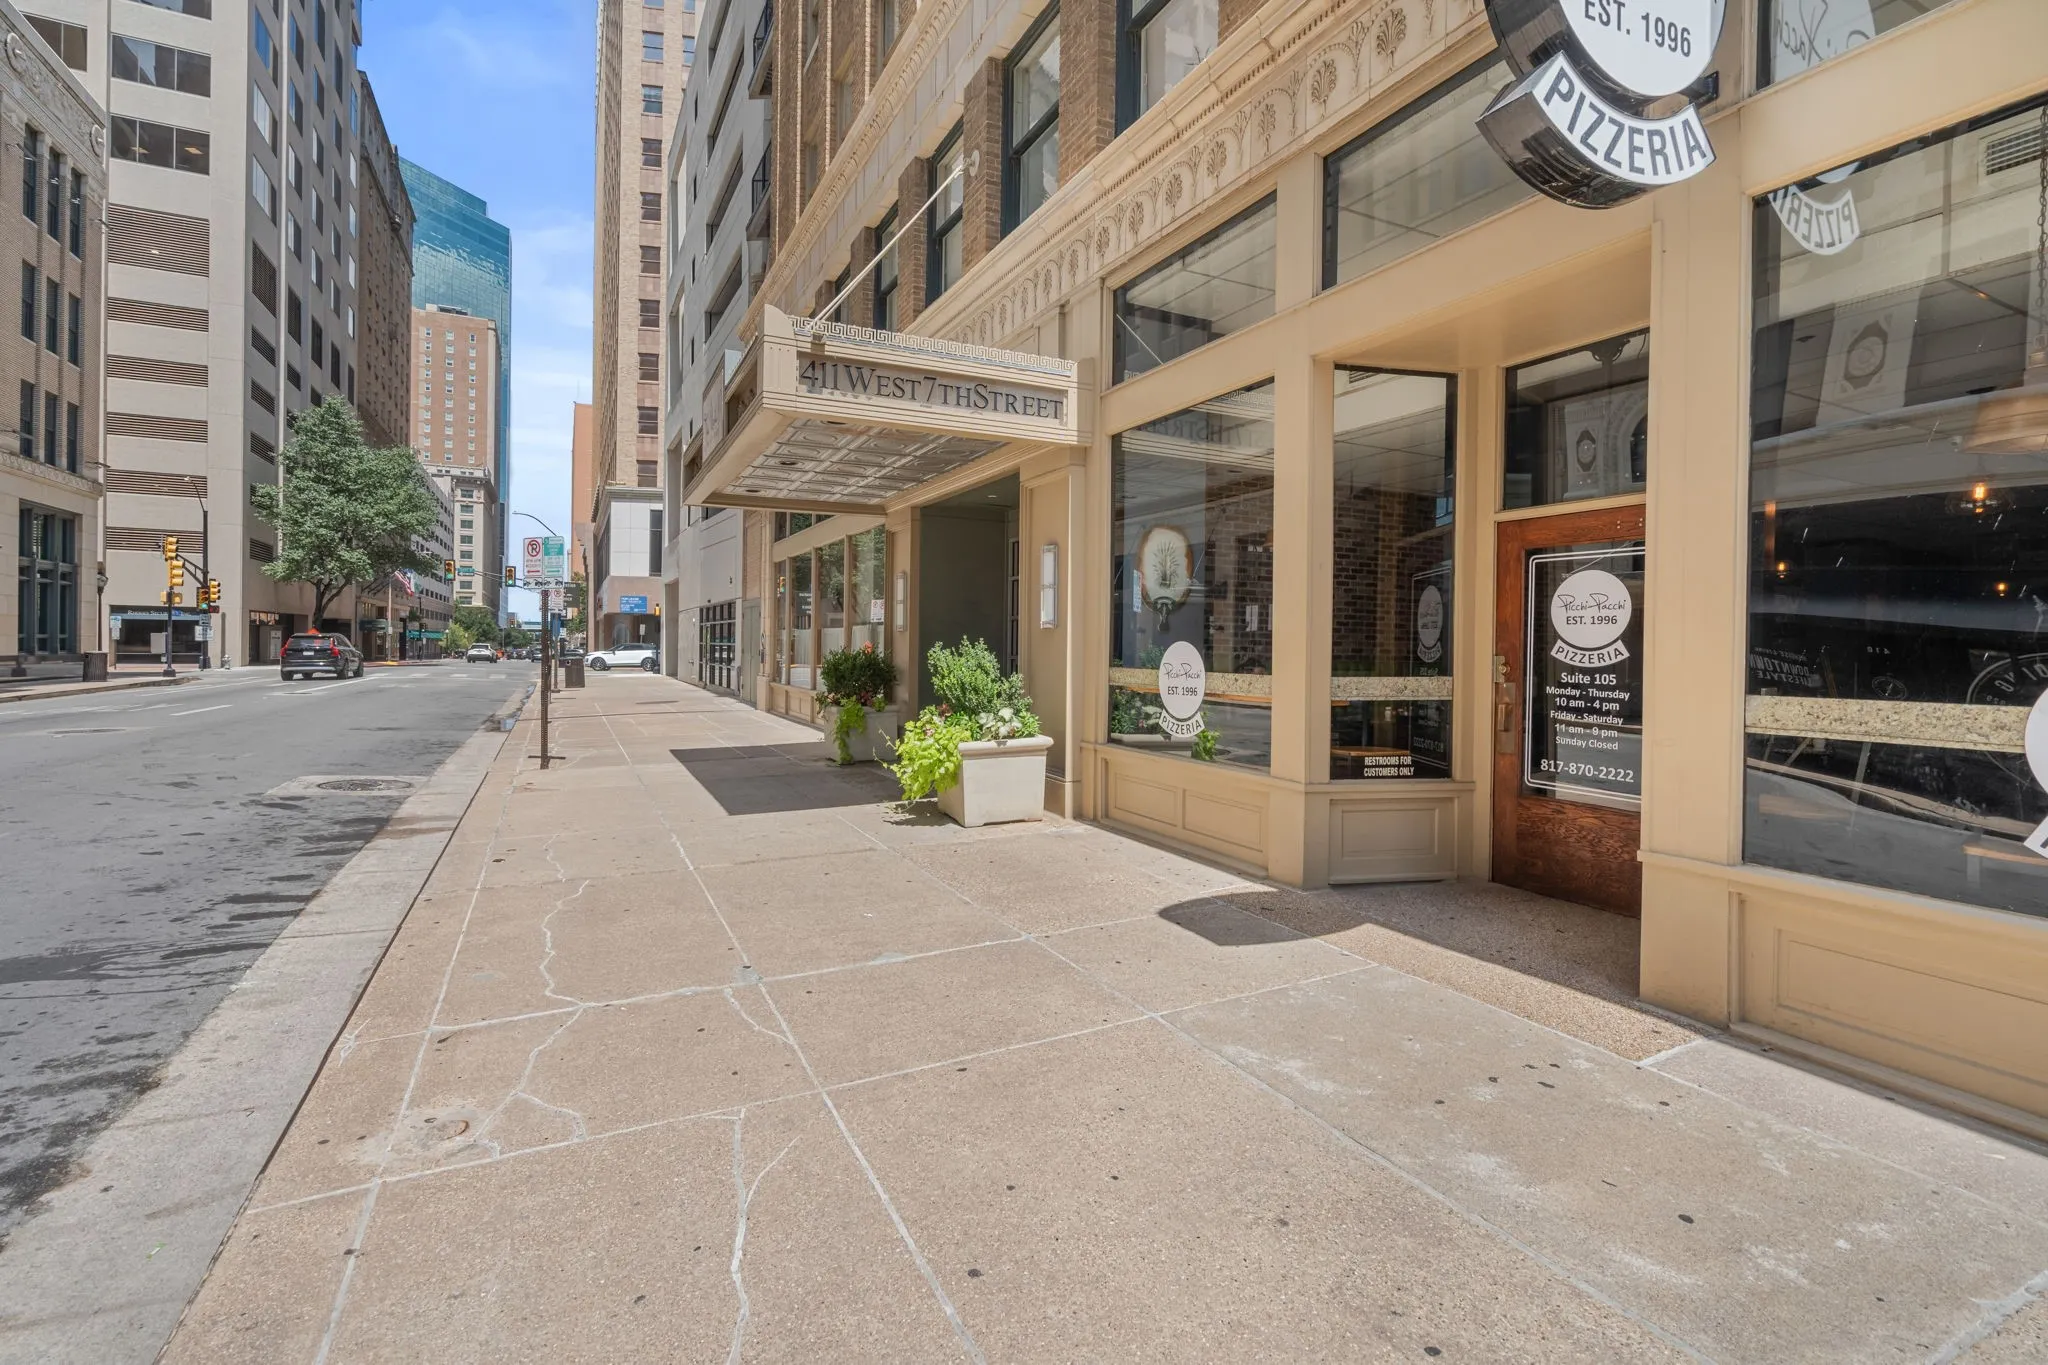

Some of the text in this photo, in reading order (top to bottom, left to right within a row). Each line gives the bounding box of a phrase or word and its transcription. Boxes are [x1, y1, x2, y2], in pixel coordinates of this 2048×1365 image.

[1584, 0, 1691, 57] EST. 1996
[1543, 66, 1707, 176] PIZZERIA
[1566, 615, 1617, 625] EST. 1996
[1555, 645, 1624, 664] PIZZERIA
[1561, 672, 1616, 685] Suite 105
[1167, 686, 1198, 697] EST. 1996
[1546, 686, 1581, 697] Monday
[1588, 688, 1630, 701] Thursday
[1555, 697, 1567, 706] 10
[1569, 699, 1585, 708] am
[1593, 700, 1600, 708] 4
[1602, 702, 1619, 711] pm
[1162, 716, 1202, 735] PIZZERIA
[1550, 710, 1576, 721] Friday
[1583, 713, 1624, 726] Saturday
[1555, 723, 1565, 732] 11
[1568, 726, 1584, 734] am
[1592, 727, 1599, 736] 9
[1601, 729, 1618, 738] pm
[1555, 736, 1619, 750] Sunday Closed
[1364, 755, 1412, 766] RESTROOMS FOR
[1364, 767, 1415, 777] CUSTOMERS ONLY
[1540, 759, 1635, 783] 817-870-2222
